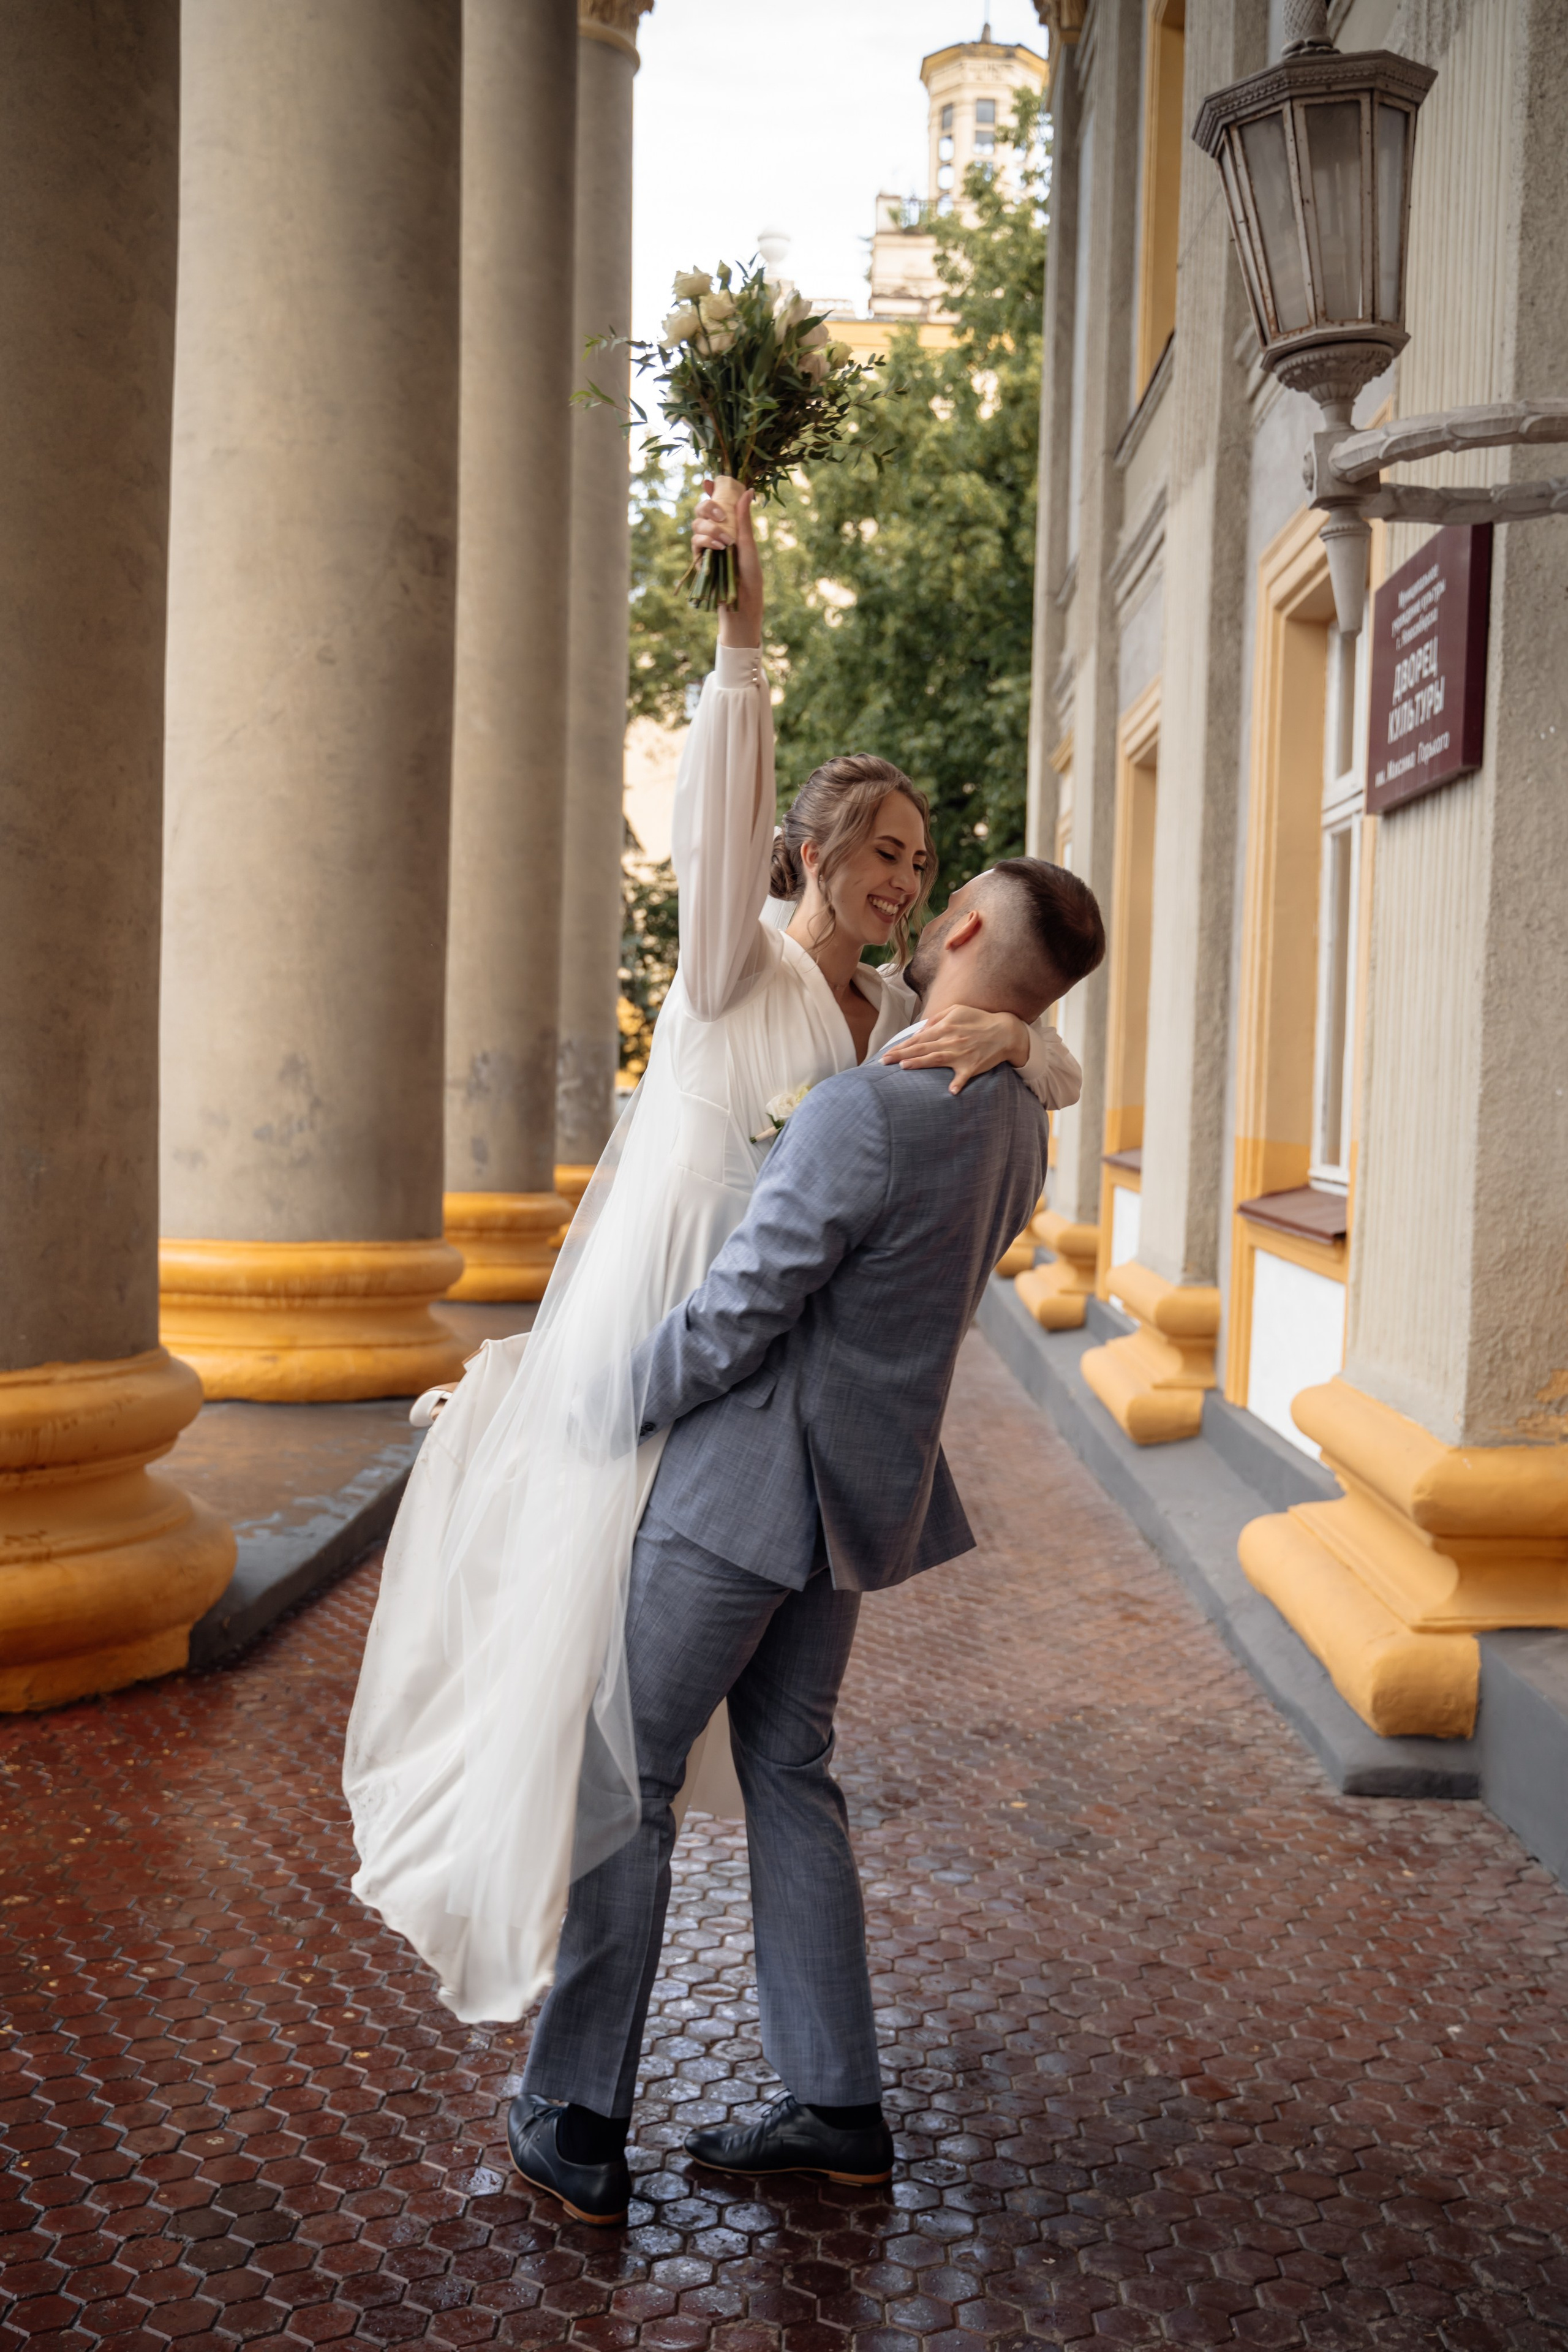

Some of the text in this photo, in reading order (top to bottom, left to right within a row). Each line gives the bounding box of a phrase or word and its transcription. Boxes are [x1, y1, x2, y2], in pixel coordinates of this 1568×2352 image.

[1392, 635, 1438, 706] ДВОРЕЦ
[1387, 675, 1445, 744] КУЛЬТУРЫ
[1387, 751, 1415, 782] Максима
[1417, 731, 1450, 766] Горького
